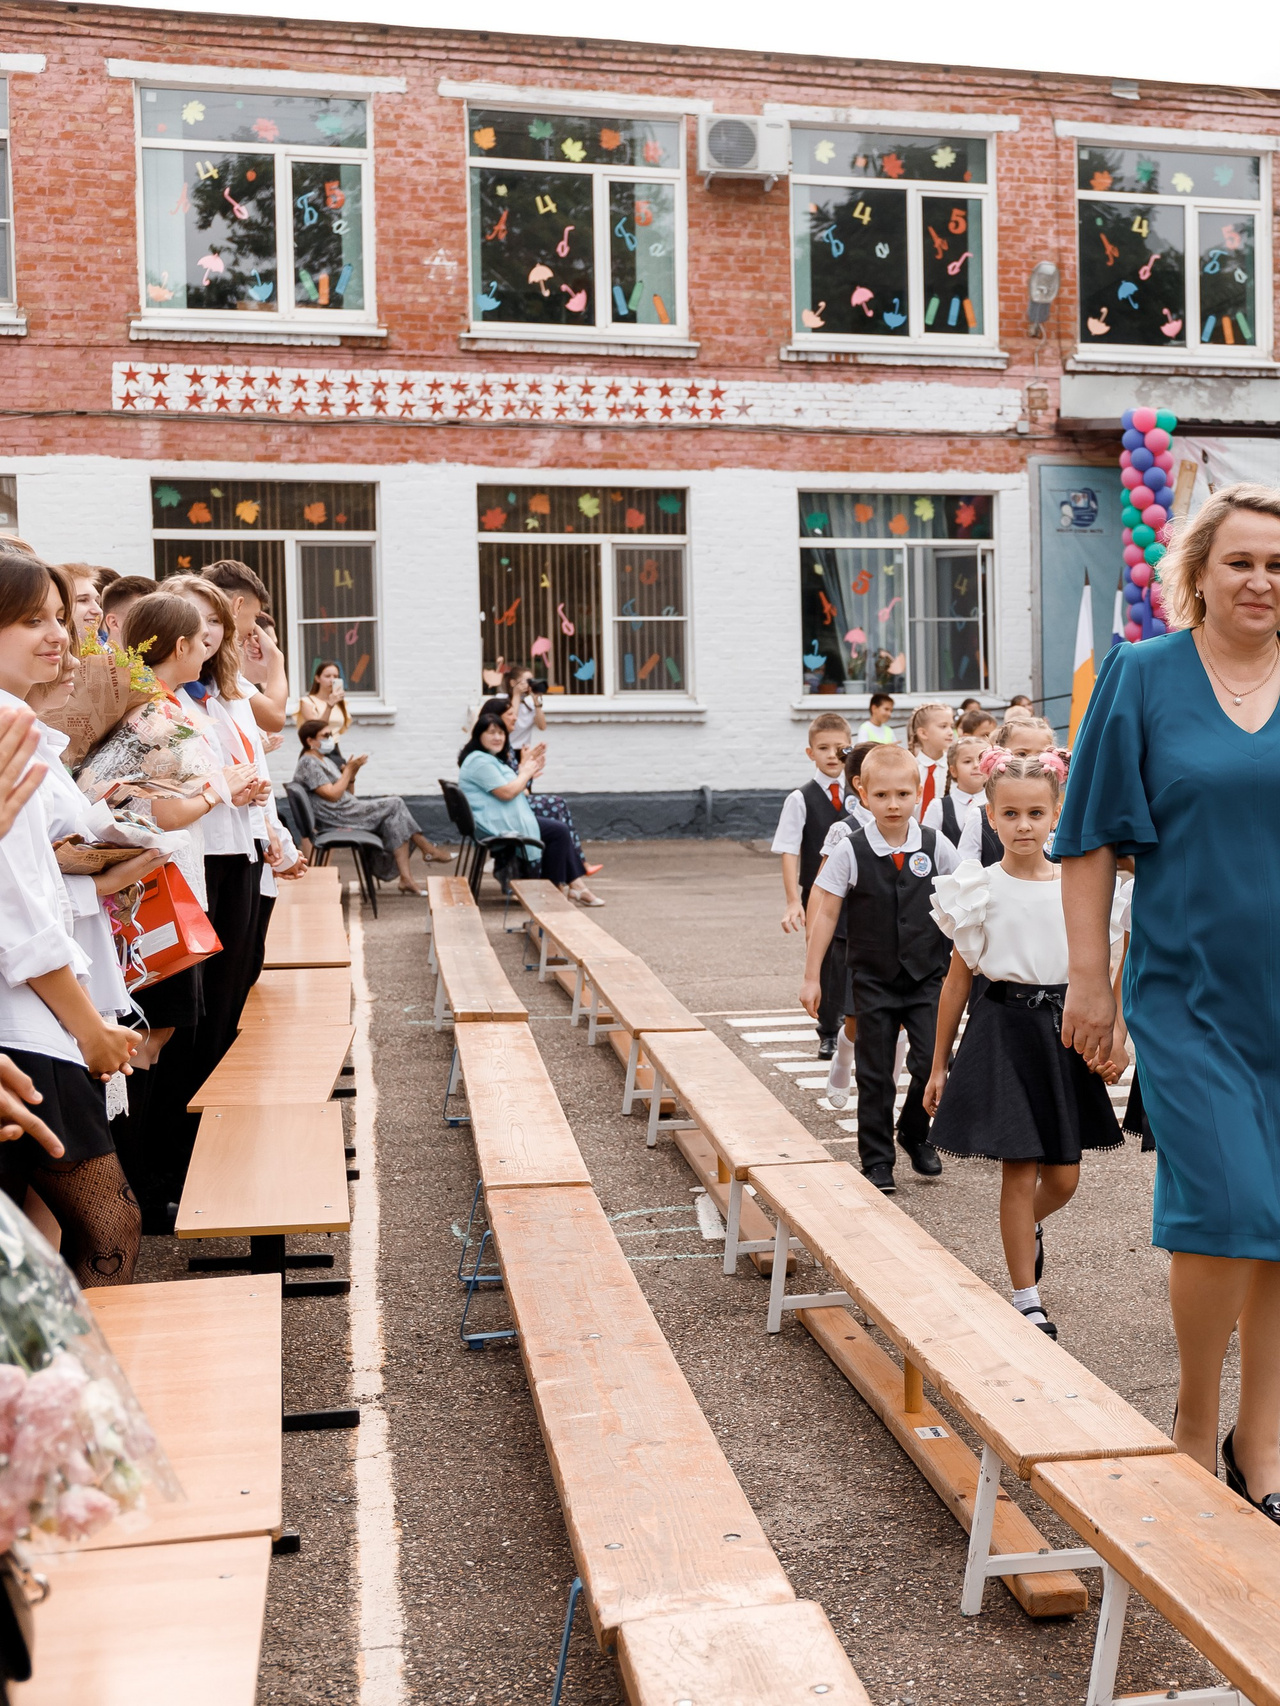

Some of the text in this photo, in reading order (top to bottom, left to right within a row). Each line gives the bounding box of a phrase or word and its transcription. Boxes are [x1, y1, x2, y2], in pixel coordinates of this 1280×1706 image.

[195, 160, 219, 180] 4
[324, 180, 346, 209] 5
[535, 194, 557, 215] 4
[634, 200, 653, 227] 5
[852, 201, 872, 226] 4
[948, 207, 967, 234] 5
[1131, 215, 1149, 238] 4
[1221, 224, 1242, 250] 5
[334, 569, 354, 590] 4
[639, 558, 659, 585] 5
[851, 569, 874, 595] 5
[954, 573, 969, 596] 4
